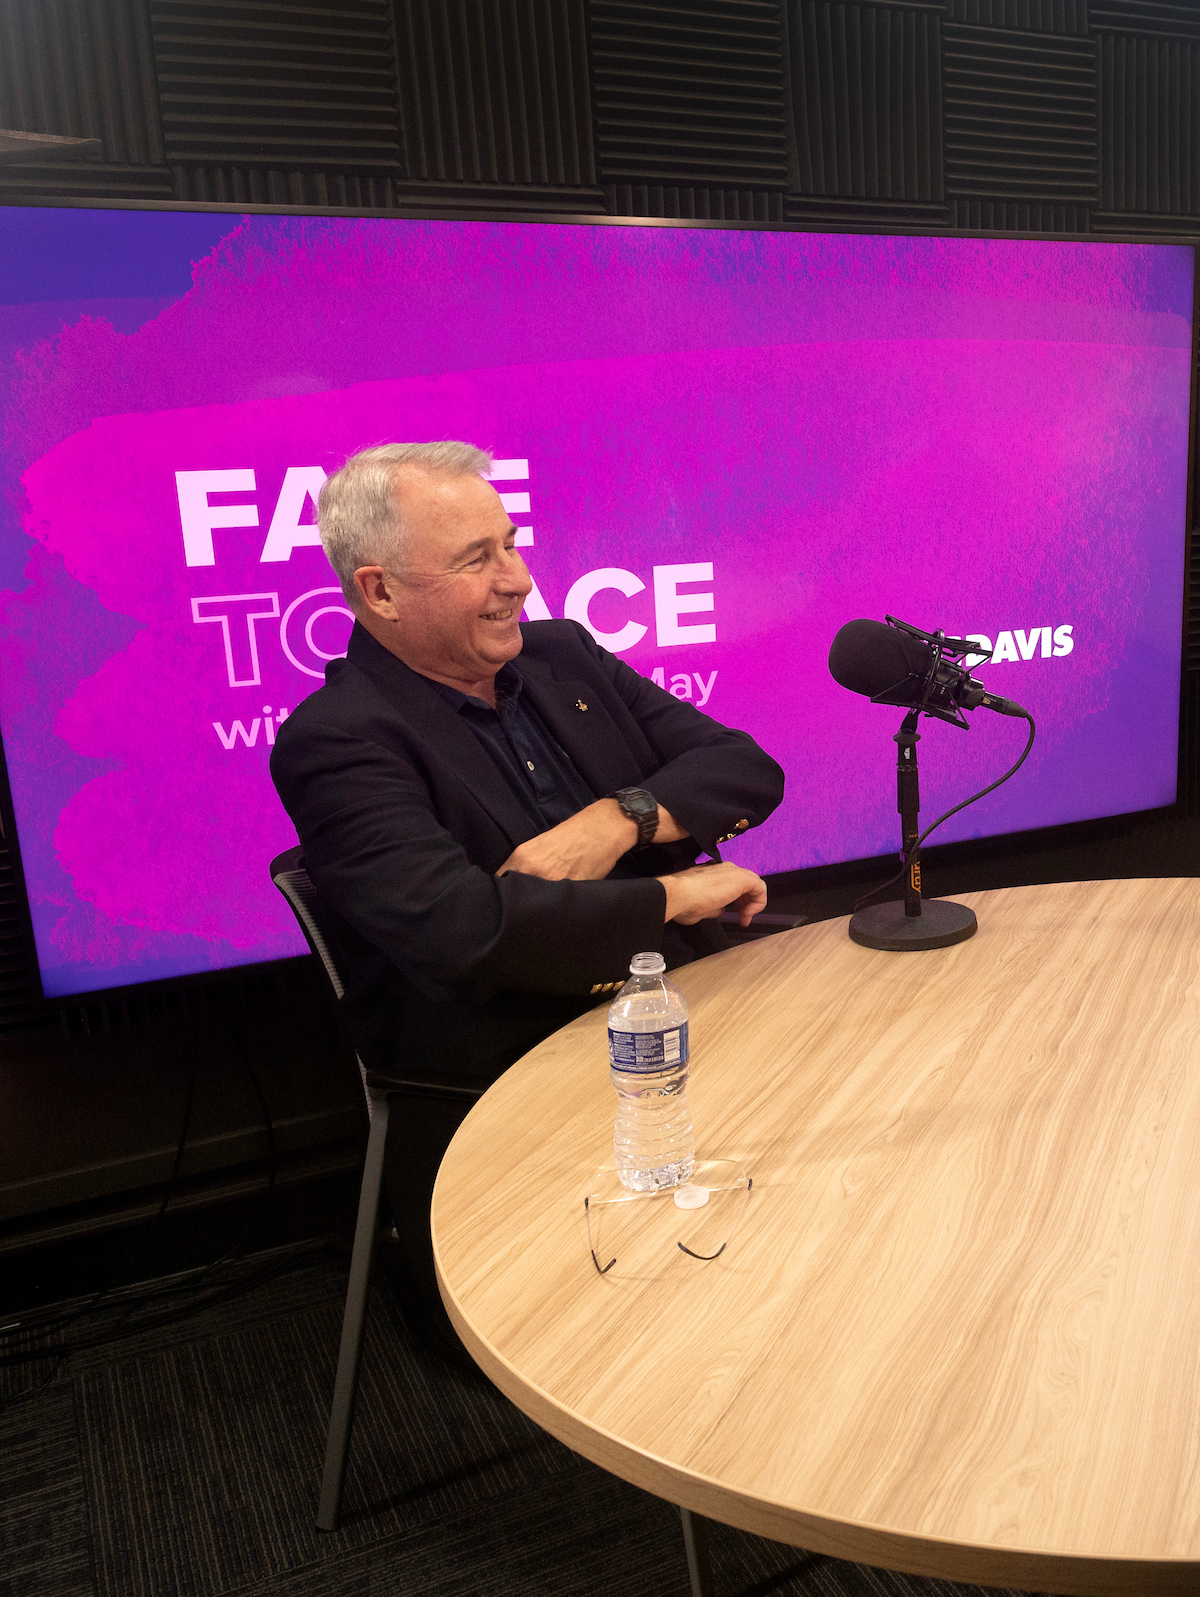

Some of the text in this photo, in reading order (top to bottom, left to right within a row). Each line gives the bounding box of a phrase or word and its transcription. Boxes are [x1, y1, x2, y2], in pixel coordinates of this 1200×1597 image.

[175, 459, 534, 567] FA
[191, 562, 717, 688] TO CE
[212, 704, 290, 750] wi
